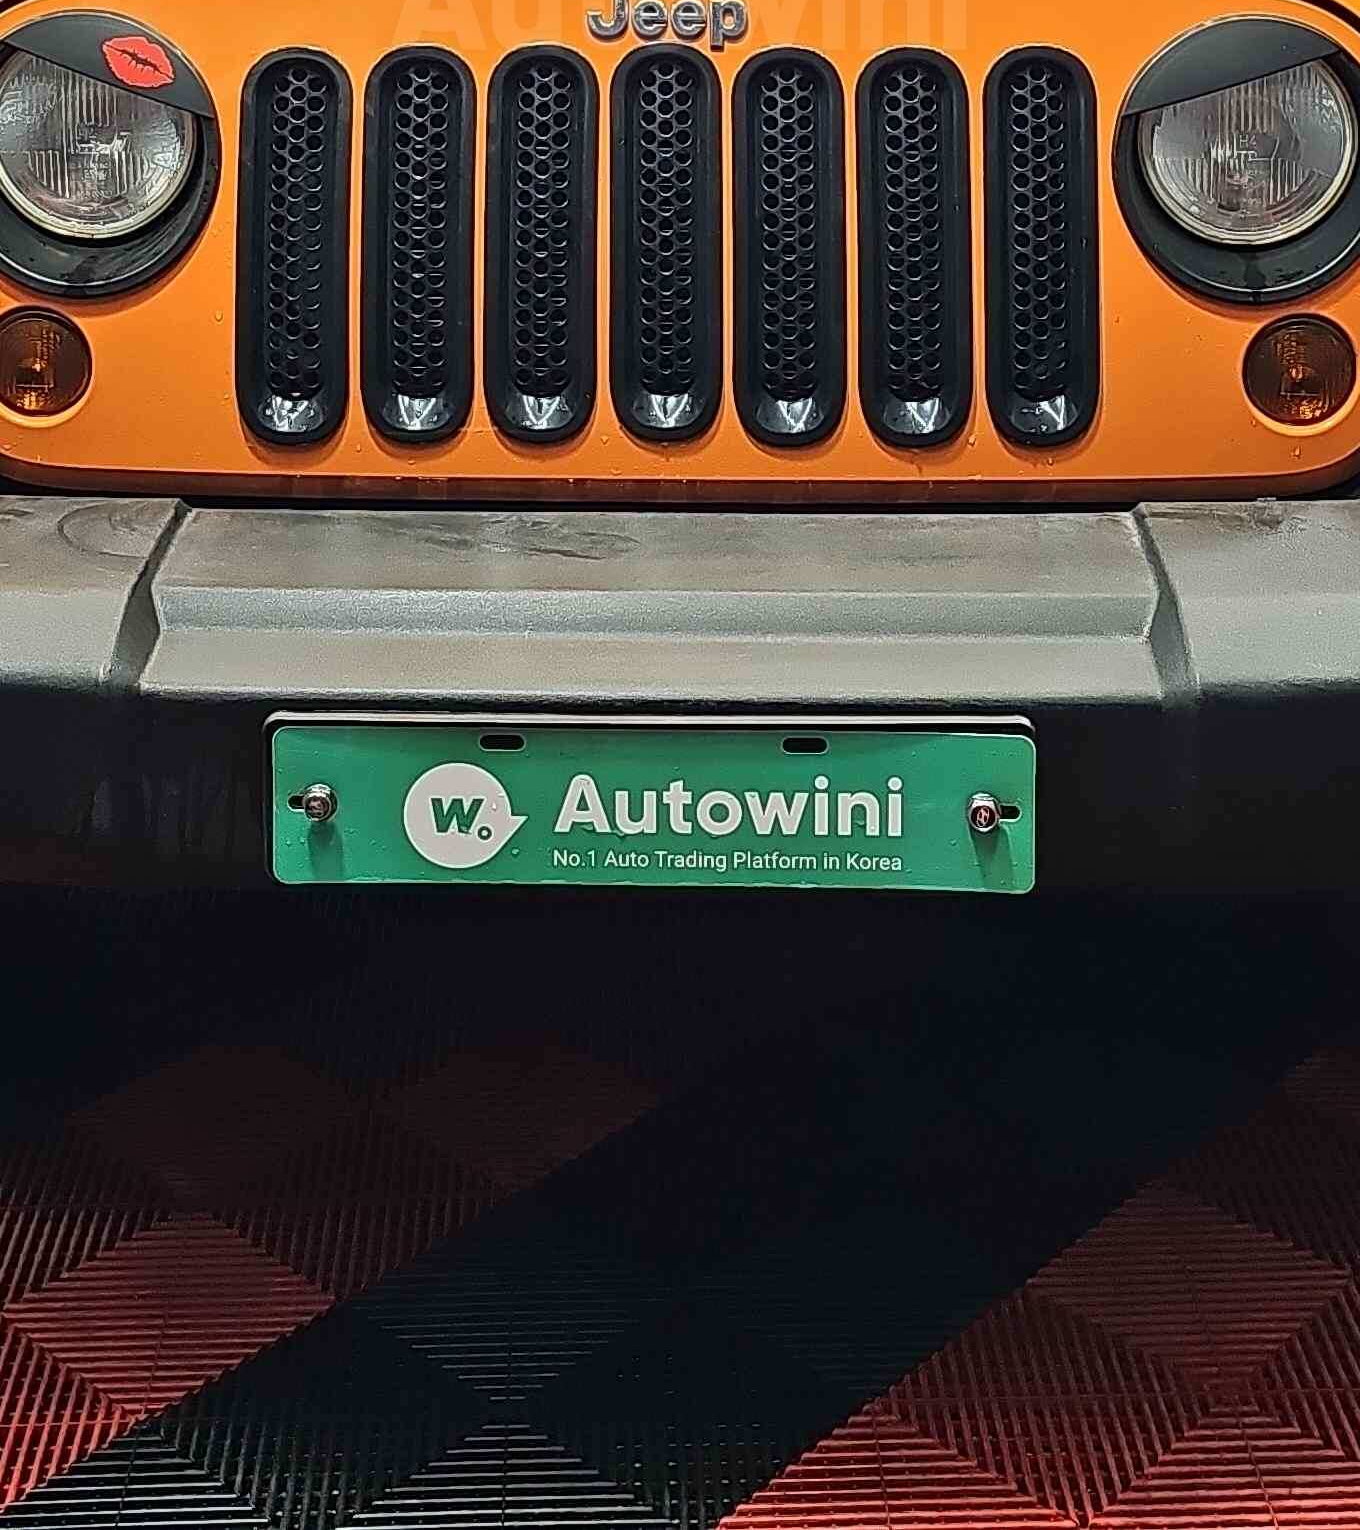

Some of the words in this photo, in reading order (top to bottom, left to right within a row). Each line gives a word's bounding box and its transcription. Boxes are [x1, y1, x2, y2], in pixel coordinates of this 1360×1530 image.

[553, 773, 904, 838] Autowini
[553, 849, 597, 868] No.1
[604, 850, 650, 869] Auto
[655, 850, 728, 872] Trading
[734, 851, 818, 871] Platform
[823, 852, 841, 870] in
[846, 853, 903, 871] Korea
